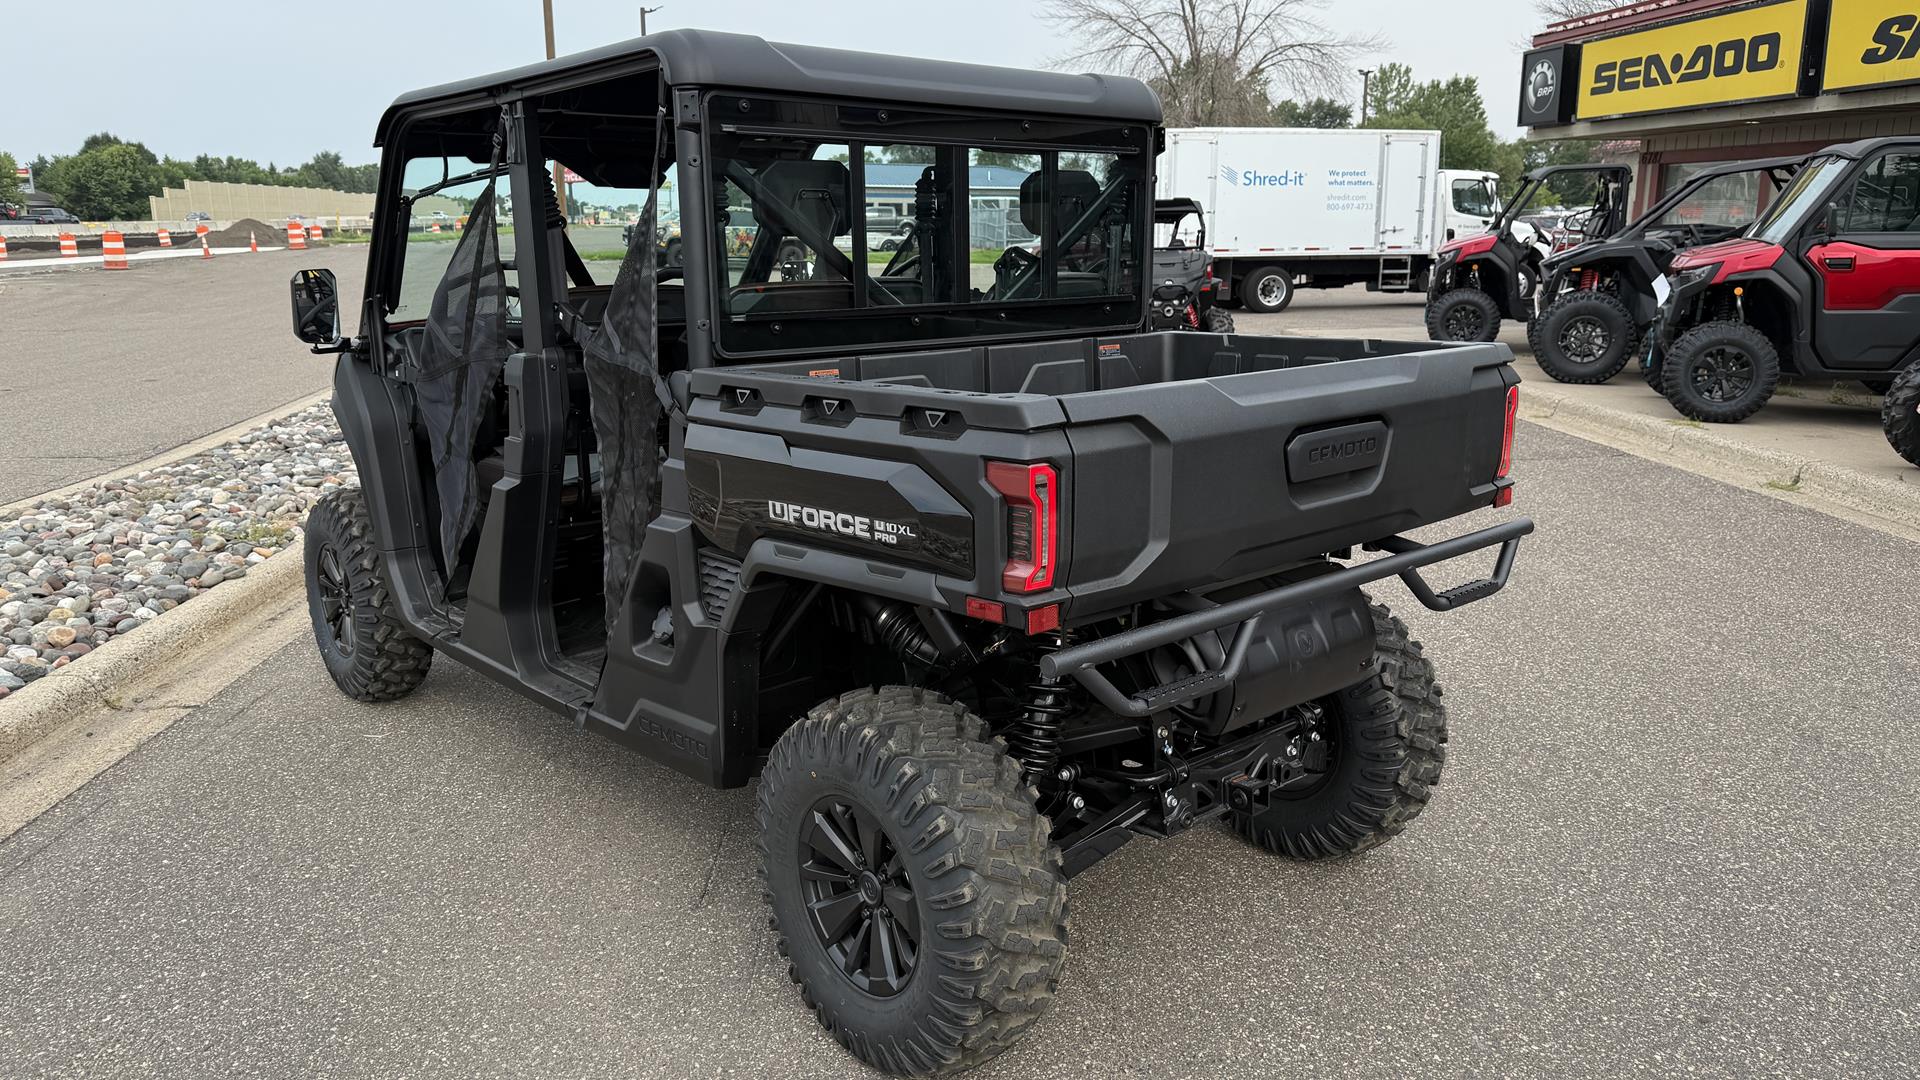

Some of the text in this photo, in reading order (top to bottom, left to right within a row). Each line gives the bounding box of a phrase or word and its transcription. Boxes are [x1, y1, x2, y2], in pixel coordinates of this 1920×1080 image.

[1537, 86, 1554, 97] BRP
[1243, 170, 1304, 186] Shred-it
[1328, 169, 1367, 178] We protect
[1327, 193, 1367, 201] shredit.com
[874, 531, 898, 545] PRO
